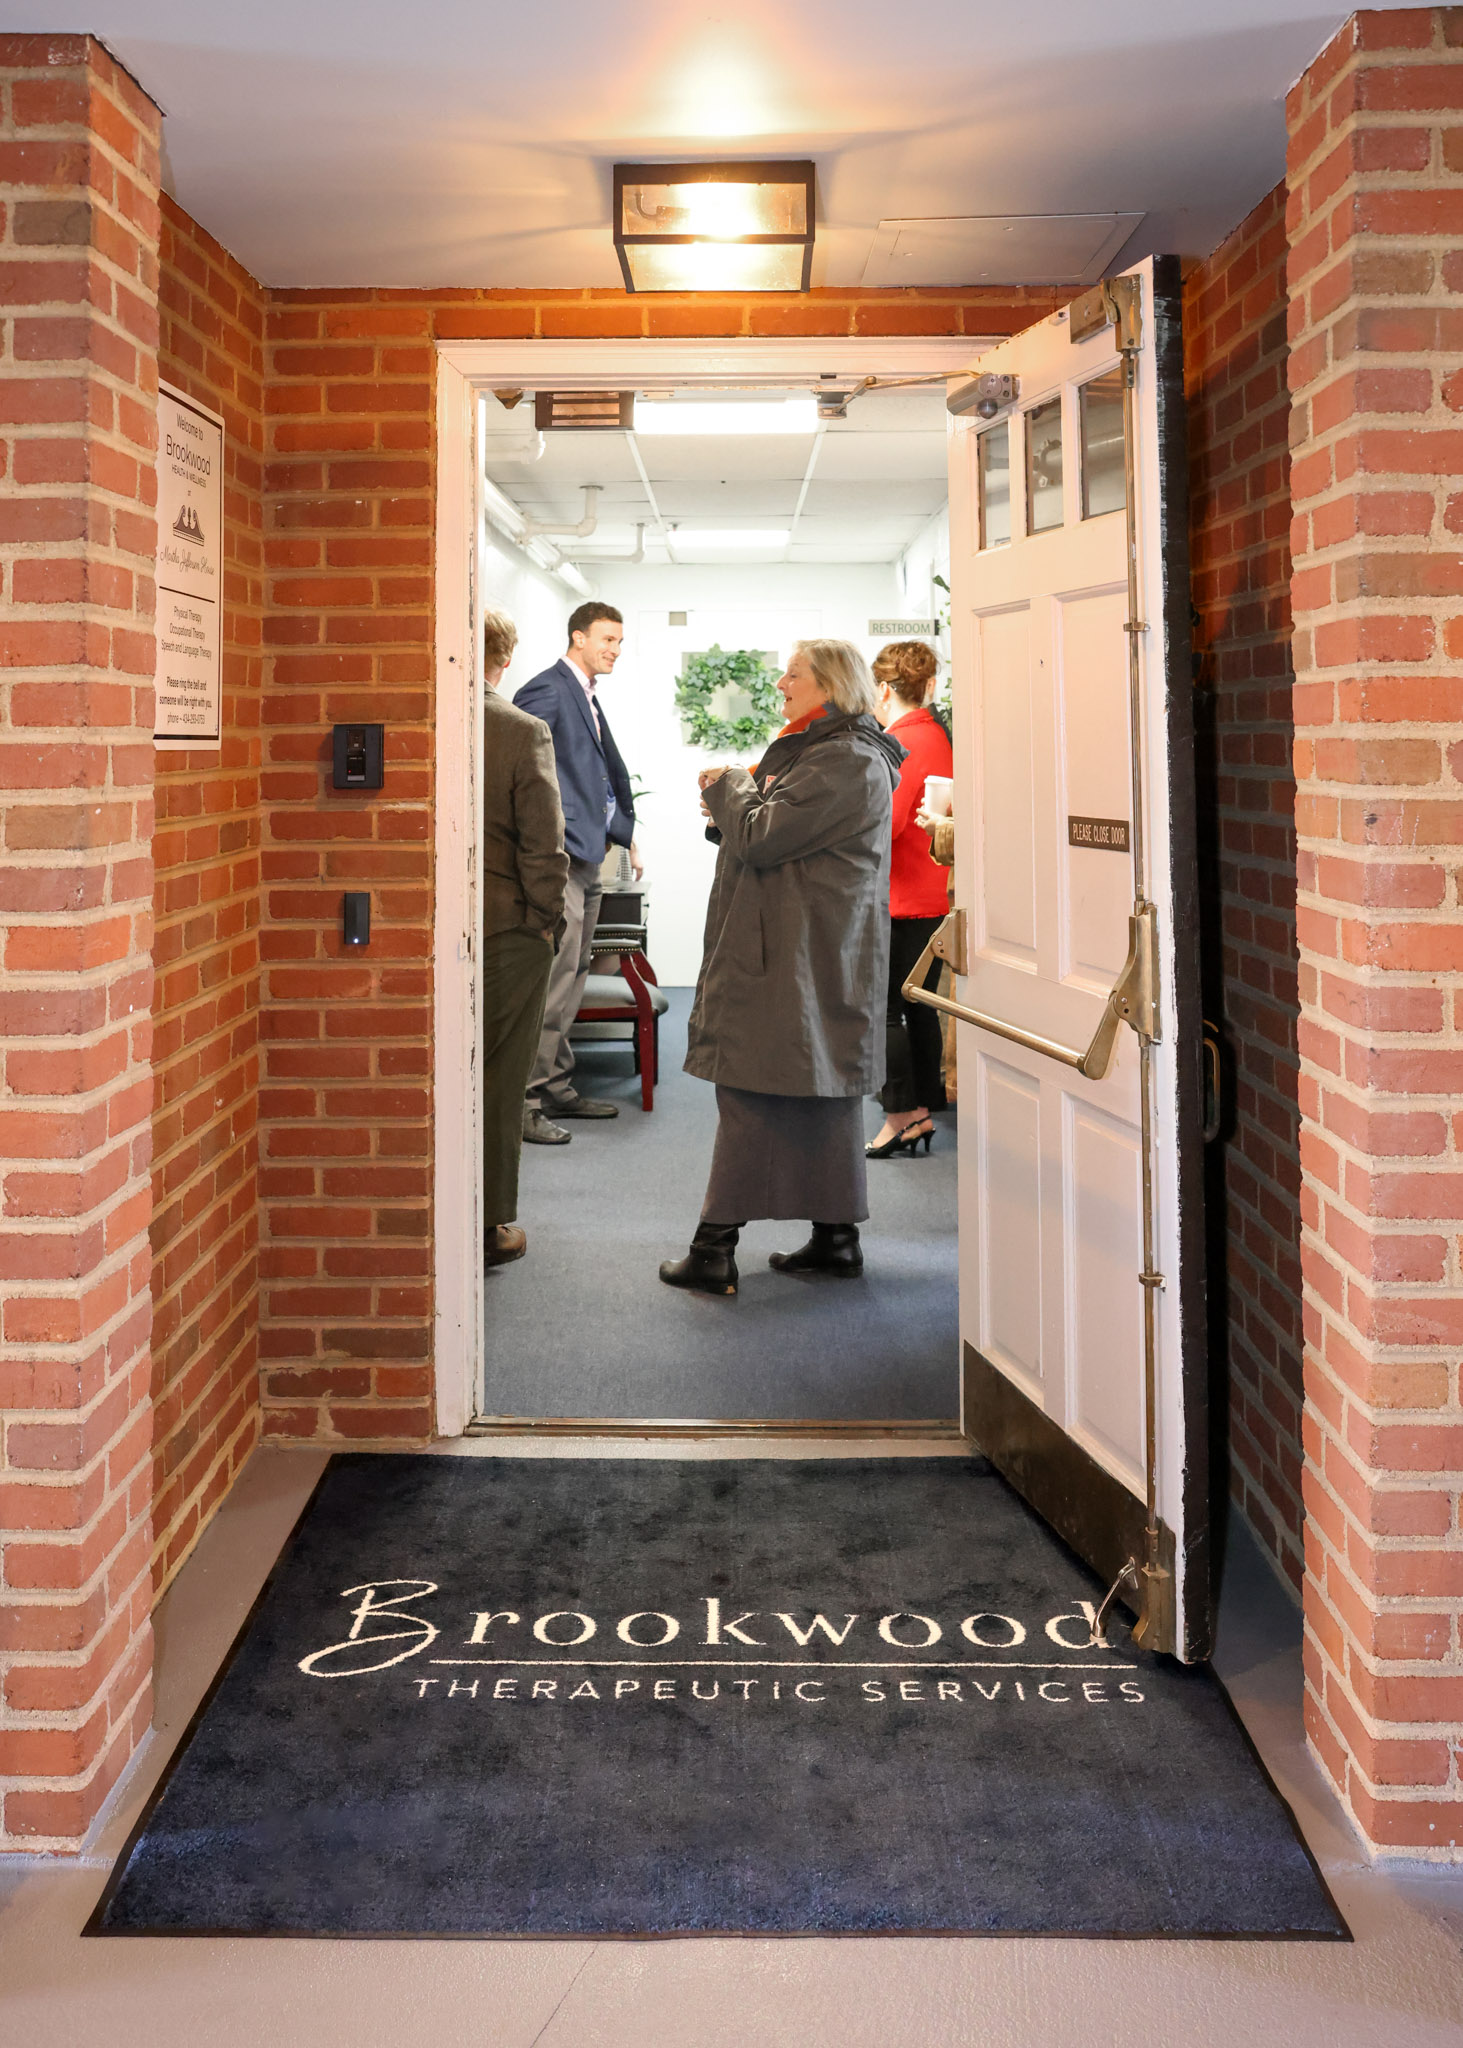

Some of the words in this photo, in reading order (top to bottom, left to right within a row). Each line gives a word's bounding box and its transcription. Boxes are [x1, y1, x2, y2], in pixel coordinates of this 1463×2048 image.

[176, 413, 198, 438] Welcome
[166, 433, 211, 476] Brookwood
[173, 605, 188, 620] Physical
[188, 609, 202, 625] Therapy
[169, 622, 192, 638] Occupational
[192, 627, 206, 643] Therapy
[872, 623, 931, 634] RESTROOM
[161, 639, 174, 652] Speech
[182, 643, 199, 659] Language
[199, 645, 212, 661] Therapy
[166, 676, 179, 688] Please
[179, 677, 187, 691] ring
[159, 695, 177, 706] someone
[189, 696, 198, 710] right
[167, 711, 179, 725] phone
[1072, 823, 1092, 842] PLEASE
[1093, 825, 1110, 844] CLOSE
[1111, 827, 1126, 845] DOOR
[297, 1579, 1116, 1678] Brookwood
[413, 1678, 825, 1702] THERAPEUTIC
[861, 1680, 1146, 1703] SERVICES
